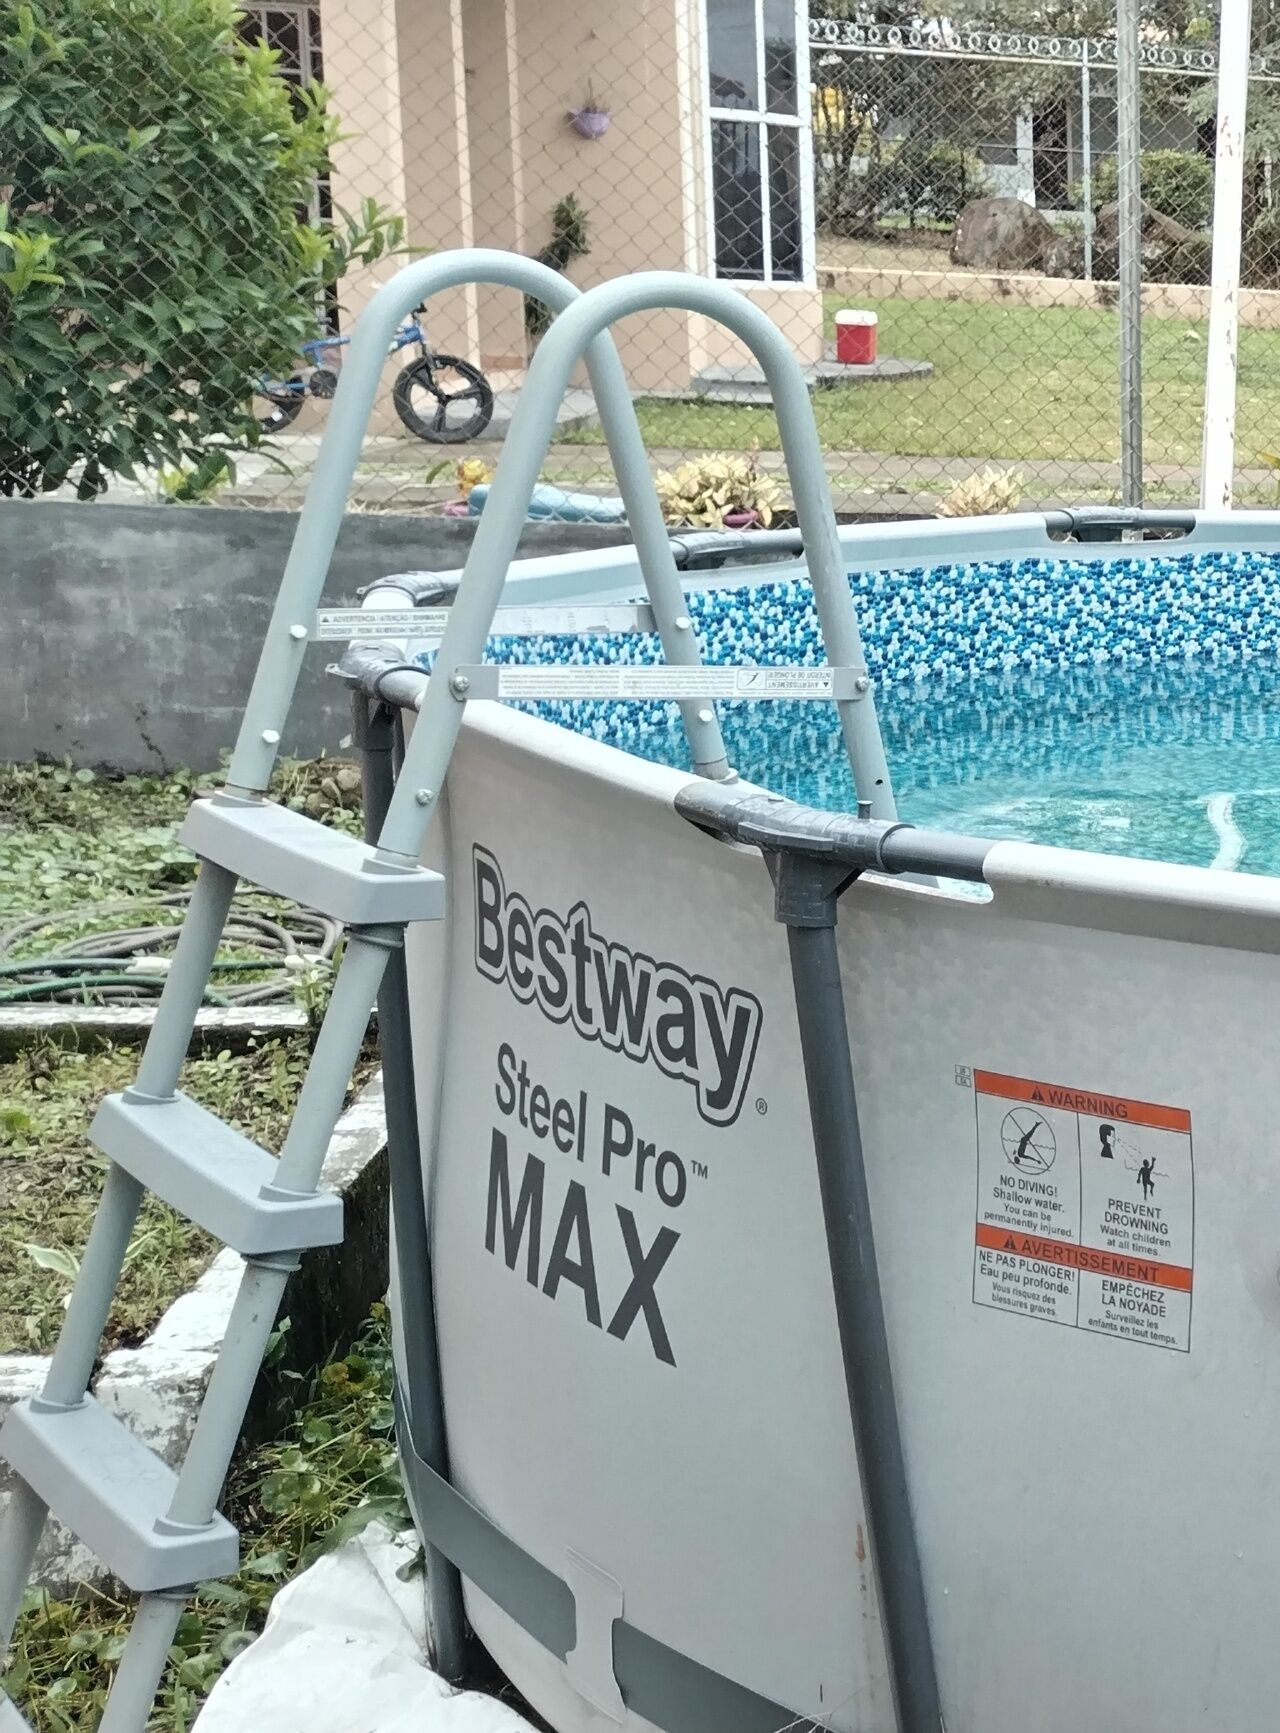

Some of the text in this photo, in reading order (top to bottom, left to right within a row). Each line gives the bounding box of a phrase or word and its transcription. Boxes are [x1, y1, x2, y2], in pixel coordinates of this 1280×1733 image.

[473, 843, 763, 1127] Bestway
[1048, 1089, 1128, 1118] WARNING
[495, 1042, 588, 1162] Steel
[601, 1102, 687, 1208] Pro
[1000, 1175, 1058, 1197] NO DIVING!
[993, 1187, 1065, 1213] Shallow water.
[1108, 1198, 1162, 1219] PREVENT
[1003, 1203, 1051, 1221] You can be
[1104, 1212, 1168, 1234] DROWNING
[984, 1211, 1074, 1238] permanently injured.
[1100, 1224, 1171, 1248] Watch children
[485, 1127, 681, 1368] MAX
[1107, 1239, 1160, 1256] at all times.
[980, 1250, 1075, 1281] NE PAS PLONGER!
[1022, 1240, 1159, 1282] AVERTISSEMENT
[980, 1264, 1072, 1295] Eau peu profonde.
[992, 1282, 1056, 1304] Vous risquez des
[992, 1293, 1028, 1309] blessures
[1102, 1280, 1165, 1303] EMPÊCHEZ
[1102, 1294, 1166, 1317] LA NOYADE
[1088, 1318, 1117, 1330] enfants
[1132, 1327, 1148, 1338] tout
[1106, 1310, 1158, 1329] Surveillez les
